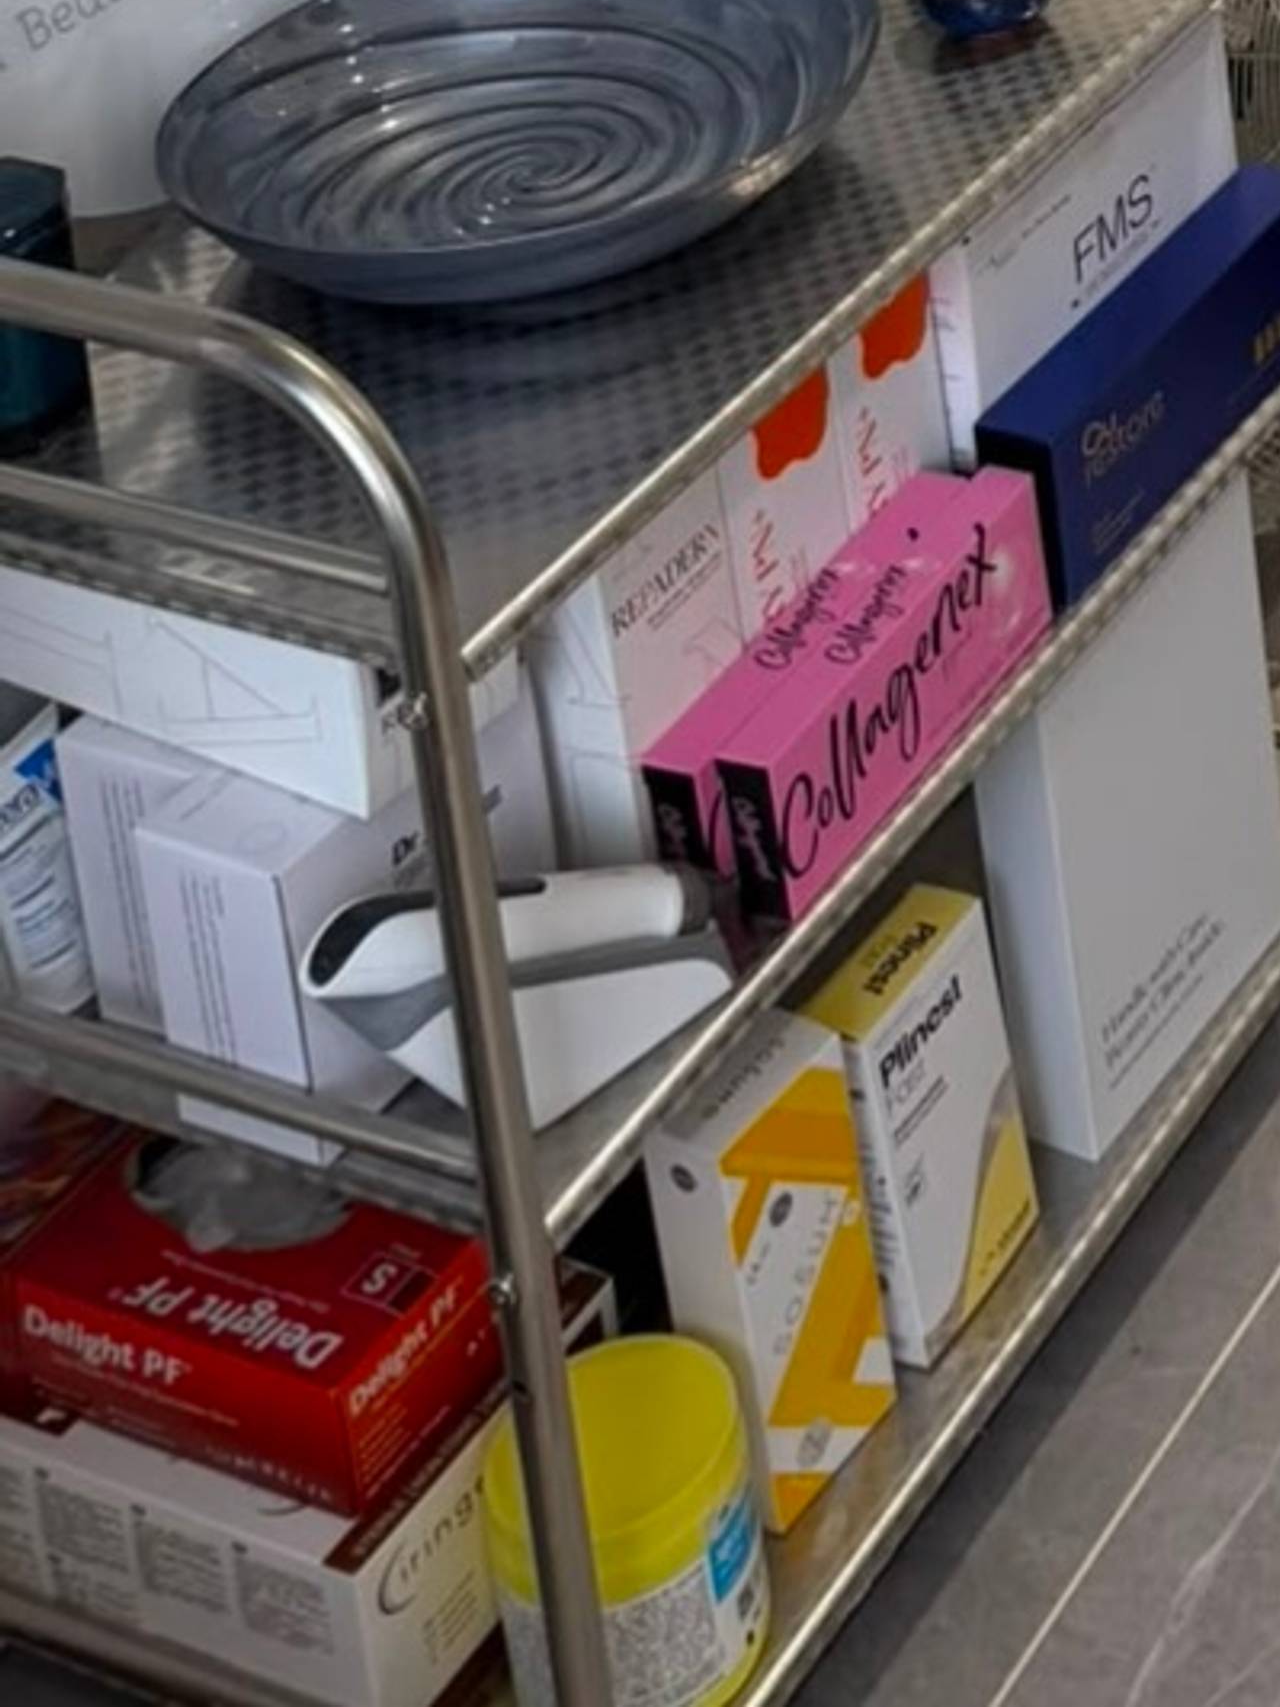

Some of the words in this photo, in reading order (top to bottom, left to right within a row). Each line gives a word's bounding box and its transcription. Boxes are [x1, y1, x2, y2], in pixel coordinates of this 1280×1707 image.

[1073, 173, 1153, 284] FMS
[780, 521, 997, 880] Collagenex
[121, 1276, 195, 1317] PF
[361, 1262, 399, 1294] S
[22, 1304, 135, 1370] Delight
[143, 1346, 187, 1385] PF
[188, 1289, 346, 1369] Delight
